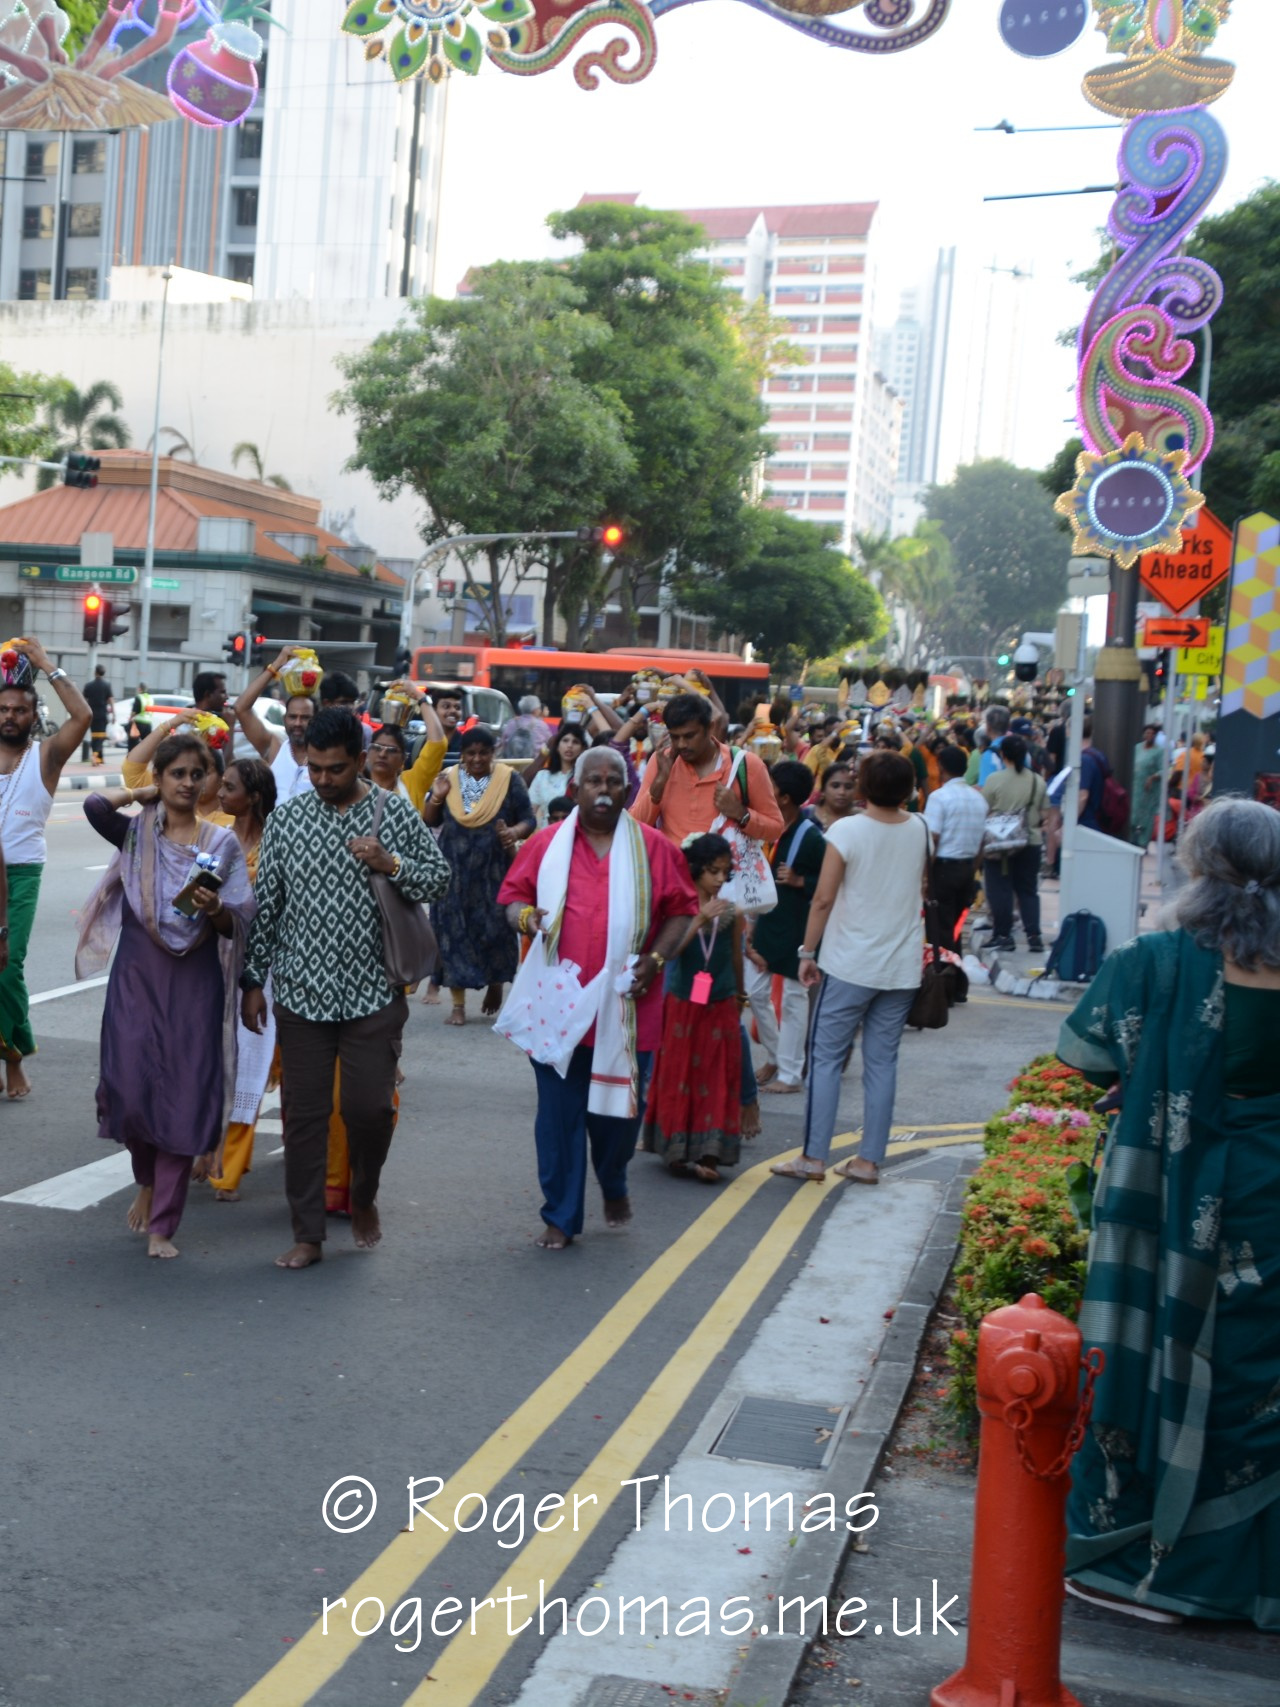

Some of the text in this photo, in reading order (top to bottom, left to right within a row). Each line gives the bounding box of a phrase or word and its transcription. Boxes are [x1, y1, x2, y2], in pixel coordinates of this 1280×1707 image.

[62, 568, 130, 580] Rangoon Rd
[1150, 558, 1212, 580] Ahead
